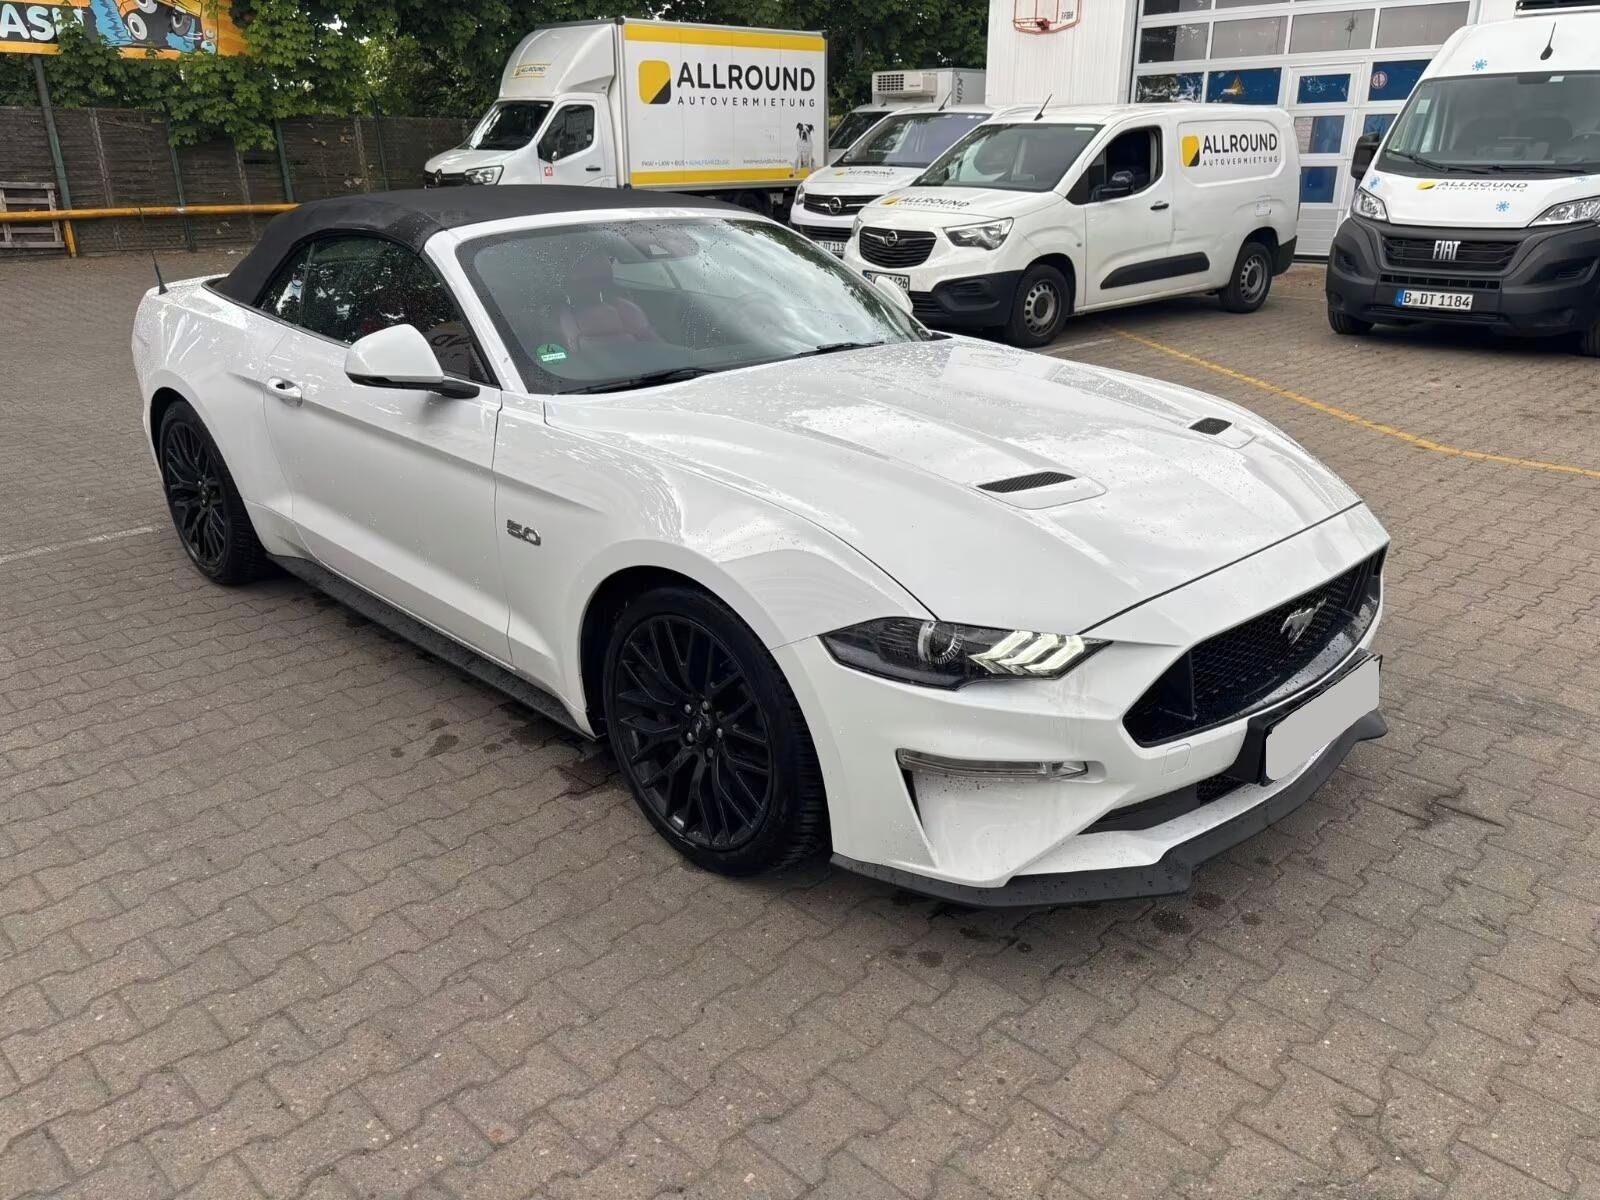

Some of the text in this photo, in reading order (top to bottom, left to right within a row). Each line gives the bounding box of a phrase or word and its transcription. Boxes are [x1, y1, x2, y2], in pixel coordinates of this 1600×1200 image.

[677, 62, 815, 91] ALLROUND
[678, 96, 815, 107] AUTOVERMIETUNG
[1203, 133, 1277, 154] ALLROUND
[1203, 156, 1278, 166] AUTOVERMIETUNG
[1433, 240, 1461, 260] FIAT
[1403, 292, 1470, 308] B DT 1184
